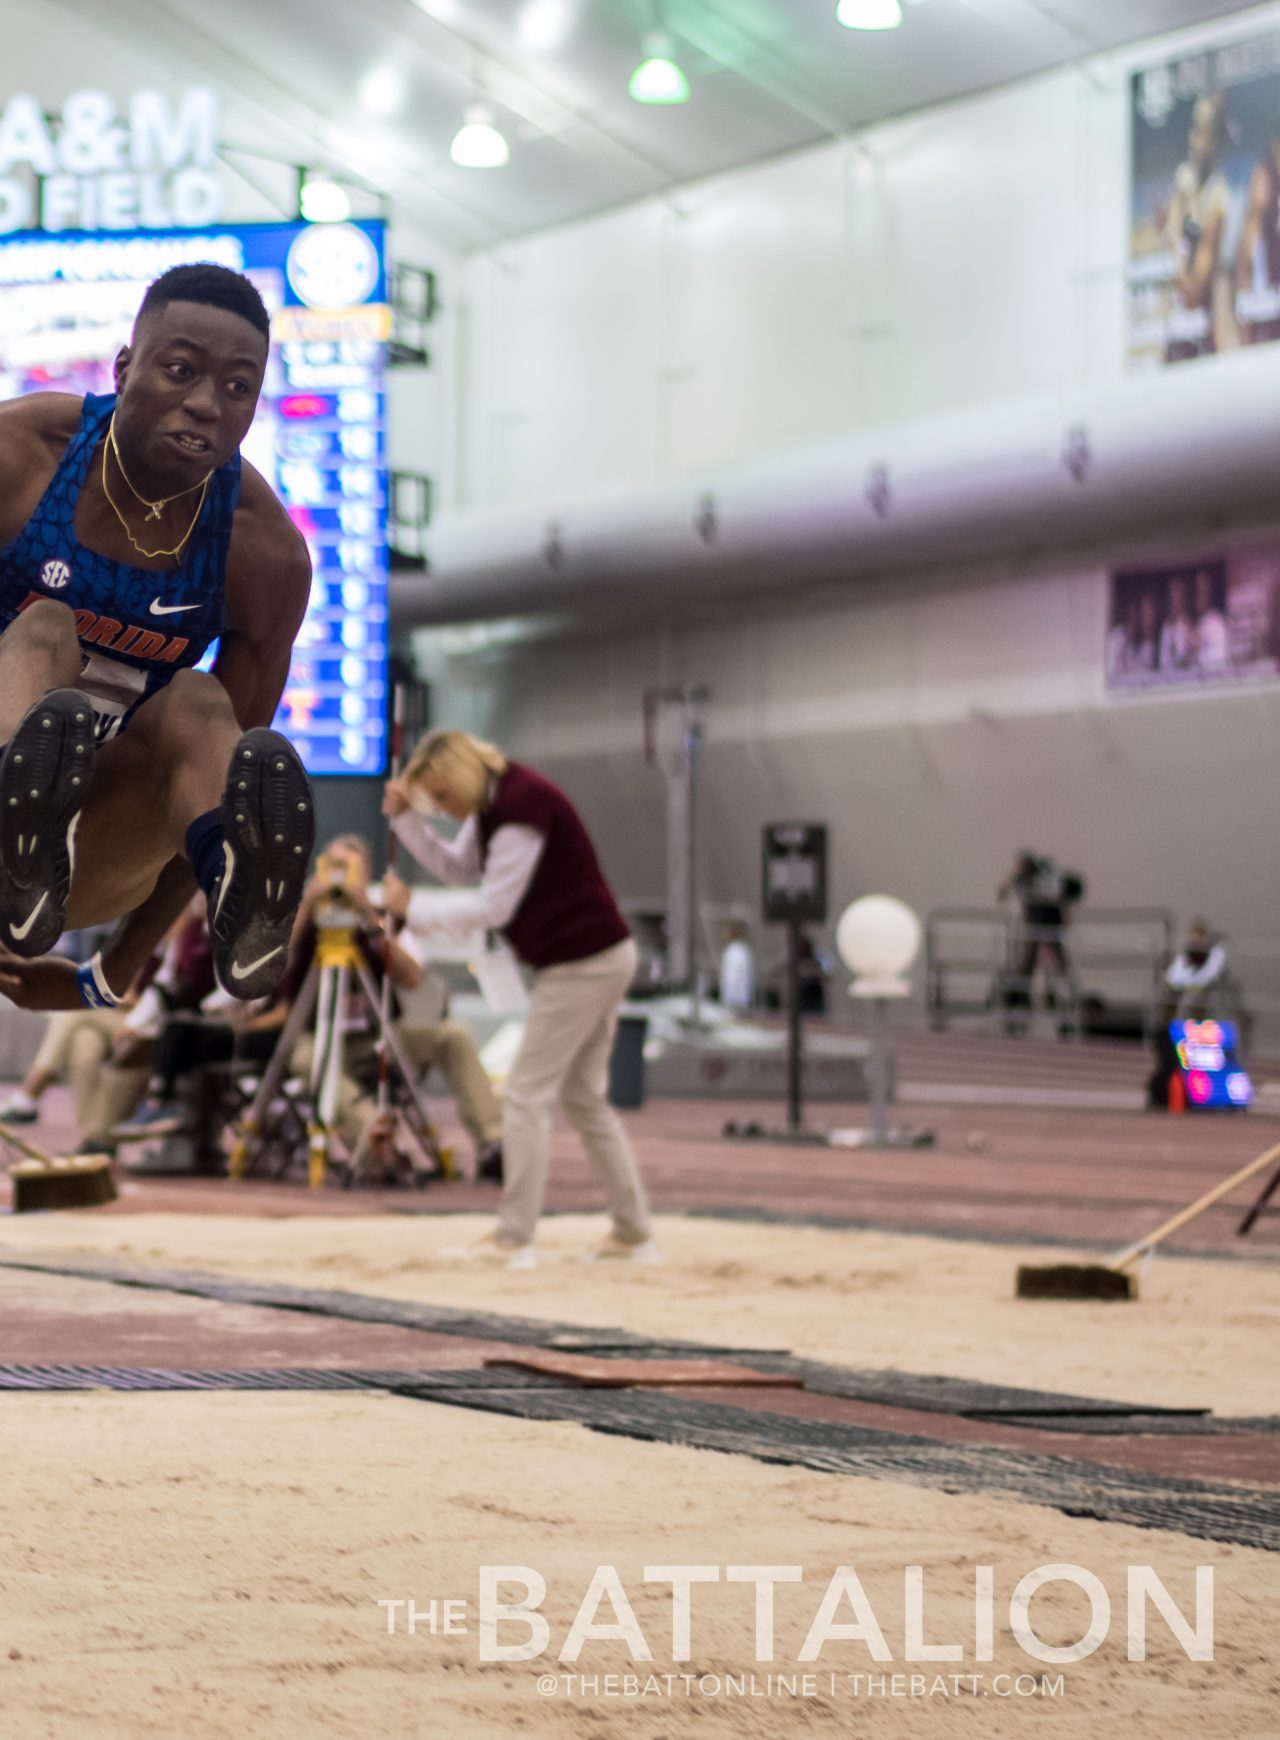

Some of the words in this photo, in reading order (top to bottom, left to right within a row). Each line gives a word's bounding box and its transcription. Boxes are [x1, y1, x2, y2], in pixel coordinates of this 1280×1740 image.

[40, 168, 220, 230] FIELD
[41, 560, 70, 588] SEC
[15, 590, 190, 663] ORIDA
